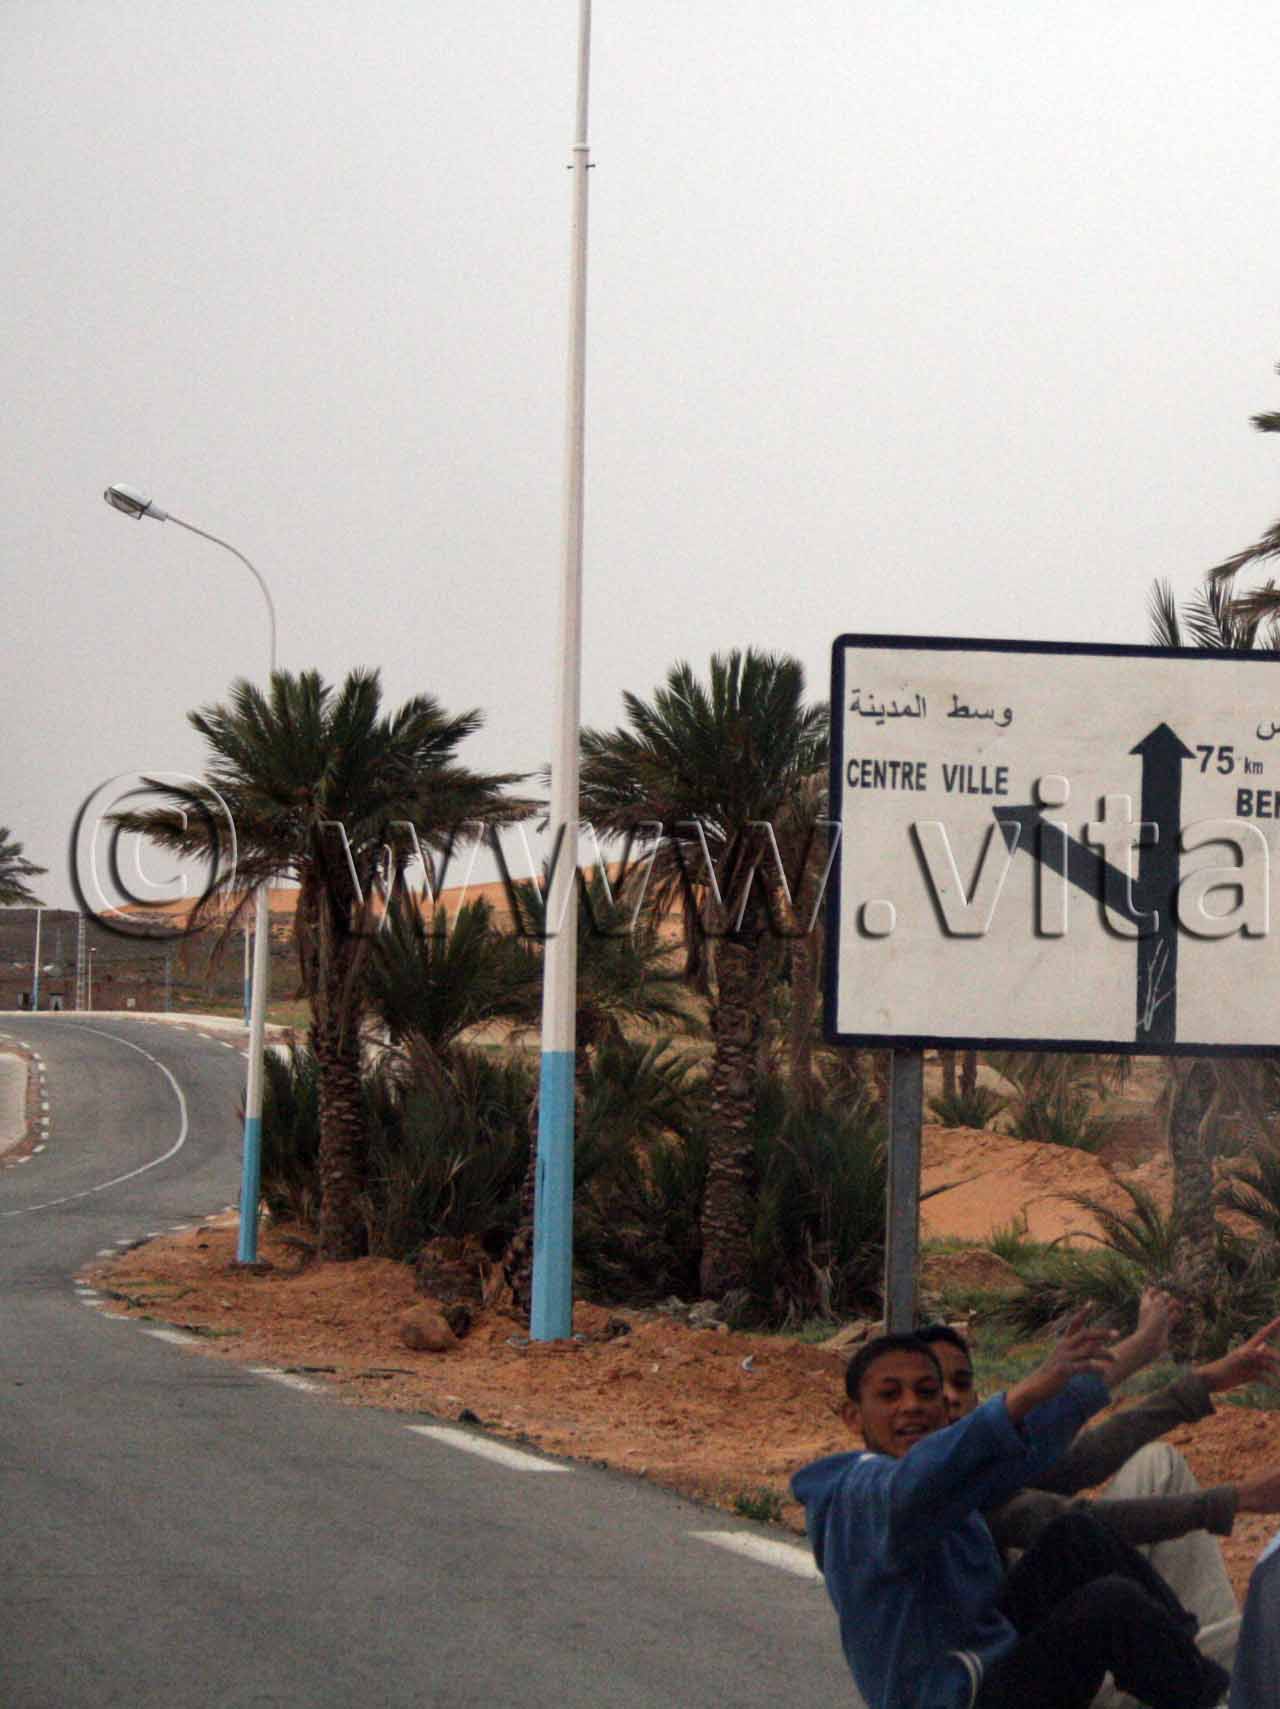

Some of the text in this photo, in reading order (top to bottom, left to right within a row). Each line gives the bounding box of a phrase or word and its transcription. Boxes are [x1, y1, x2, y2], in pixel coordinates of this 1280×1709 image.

[849, 688, 1013, 727] وسط المدينة
[847, 759, 1008, 796] CENTRE VILLE
[1196, 744, 1263, 776] 75 km
